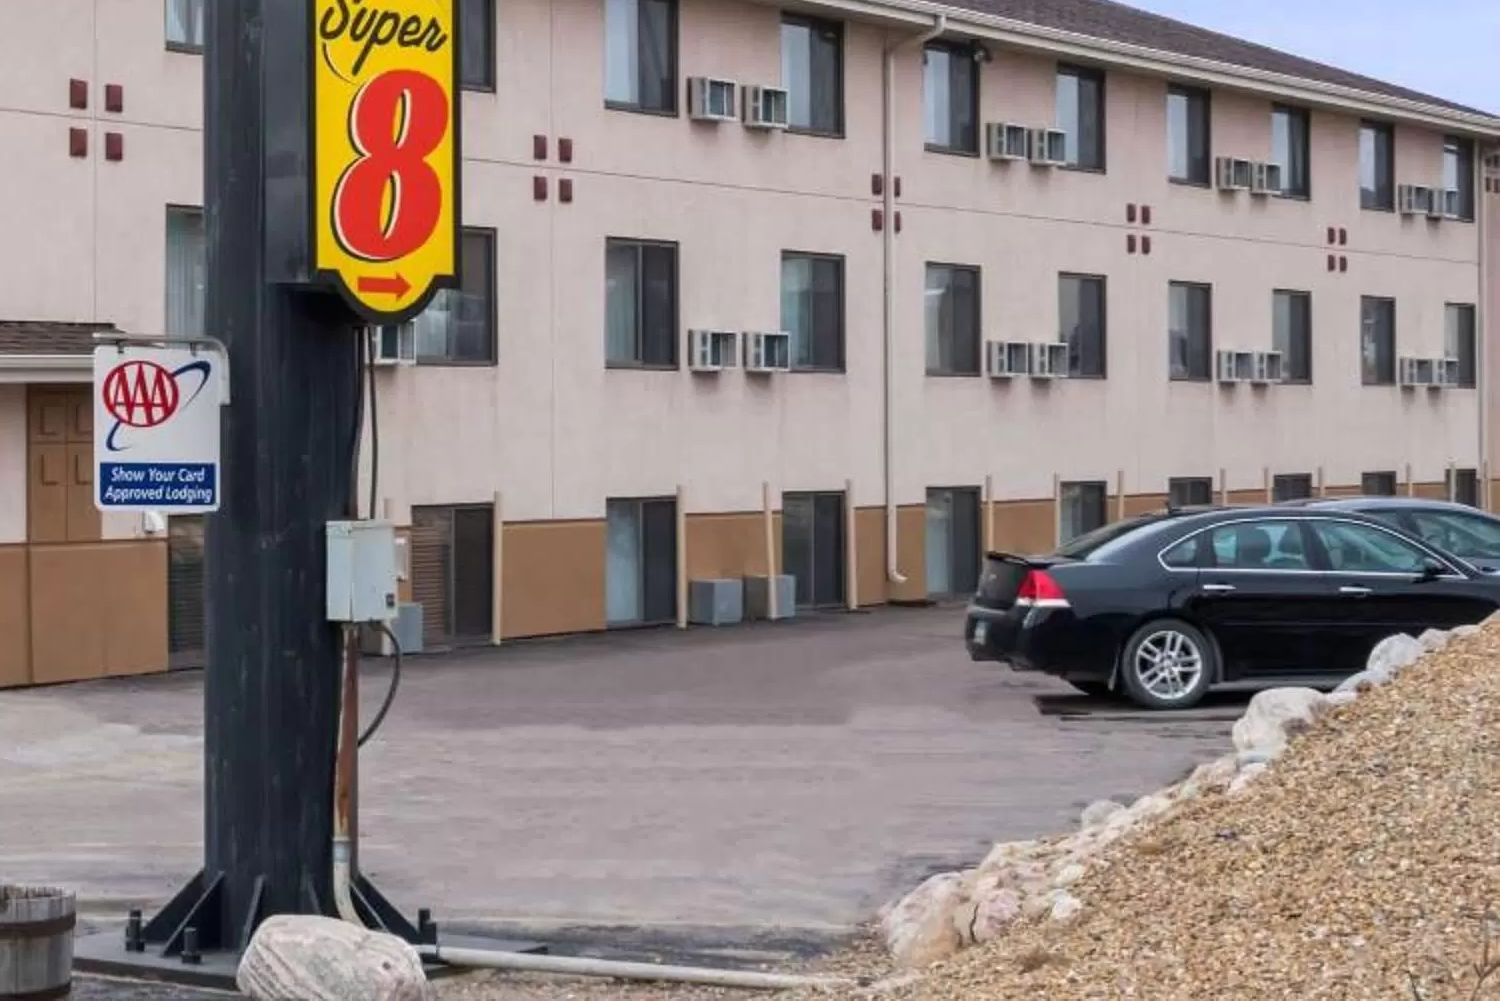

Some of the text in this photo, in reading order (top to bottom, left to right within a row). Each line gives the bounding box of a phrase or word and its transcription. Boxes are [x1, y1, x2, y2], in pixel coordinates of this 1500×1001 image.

[330, 69, 449, 263] 8
[107, 361, 175, 427] AAA
[105, 484, 212, 504] Approved Lodging
[111, 466, 205, 482] Show Your Card
